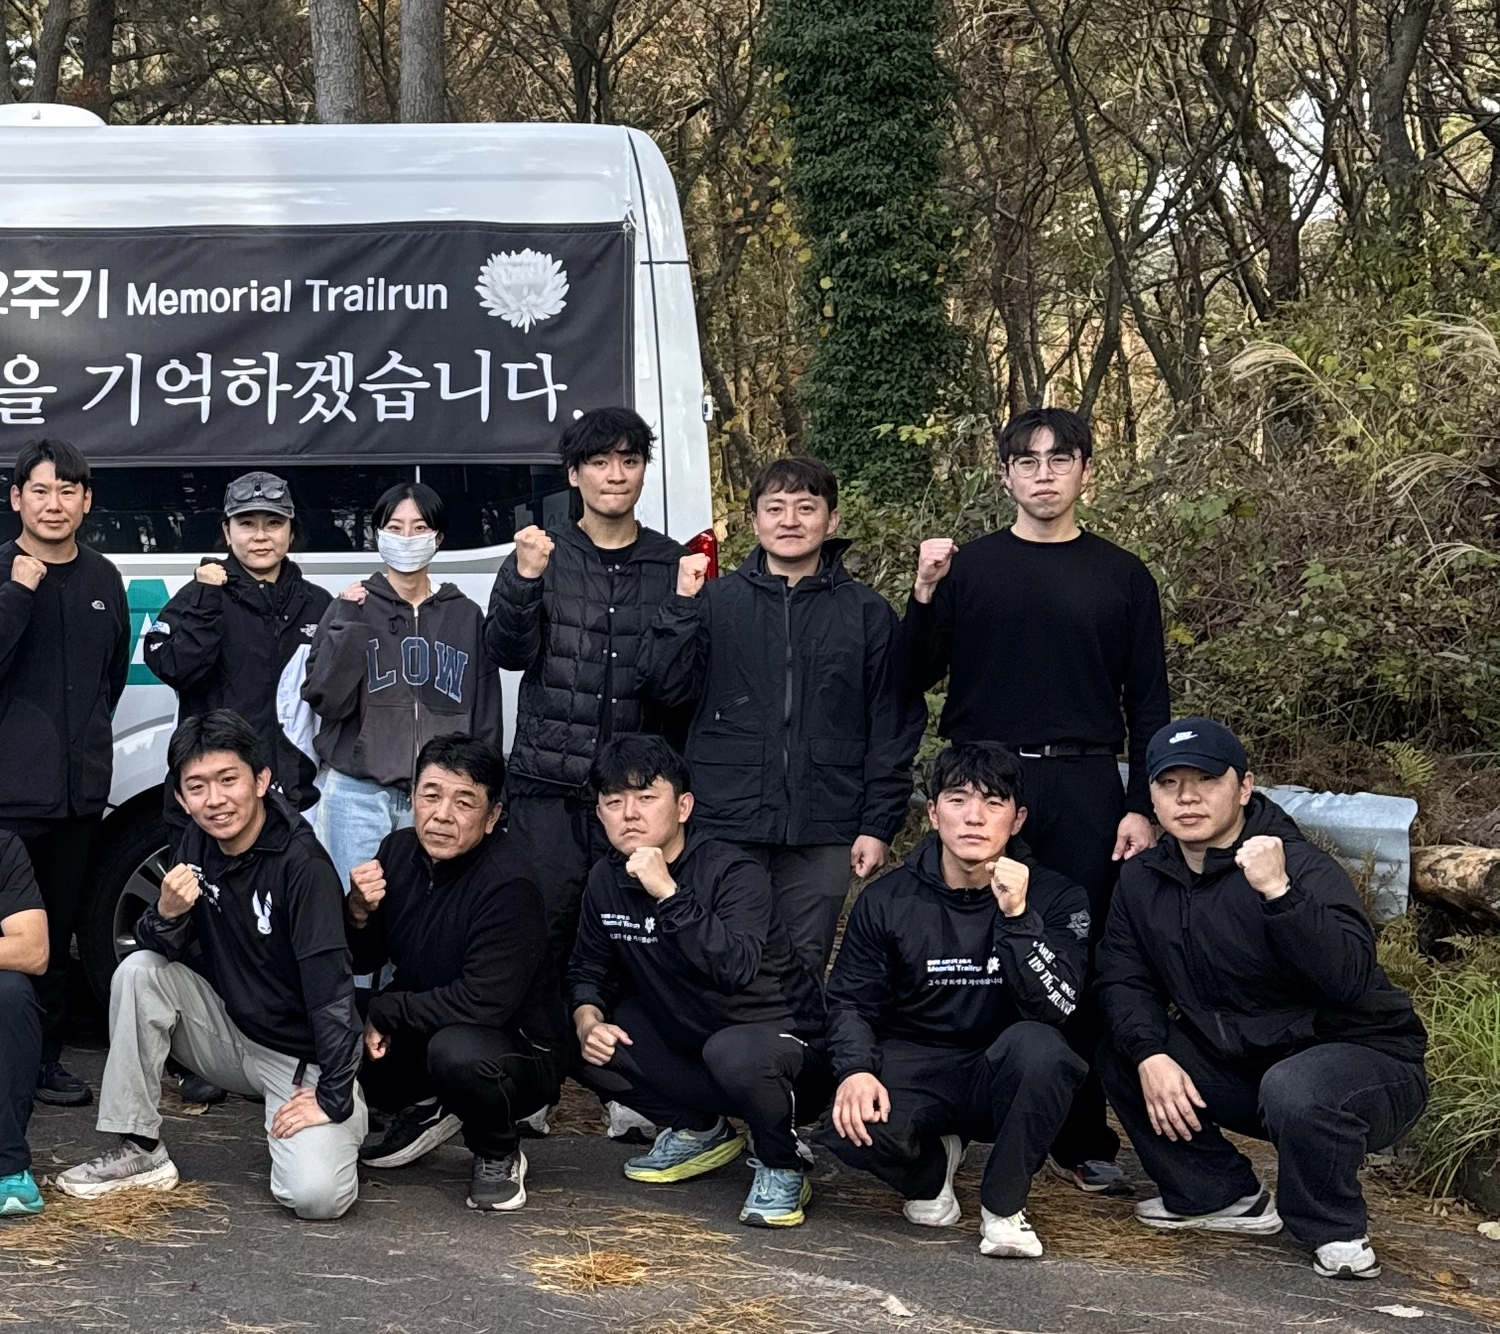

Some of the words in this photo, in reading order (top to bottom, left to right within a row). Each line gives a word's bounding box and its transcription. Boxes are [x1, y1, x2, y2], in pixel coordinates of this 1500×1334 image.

[127, 279, 292, 316] Memorial
[305, 277, 448, 313] Trailrun
[82, 349, 585, 426] 기억하겠습니다.
[366, 636, 468, 703] LOW
